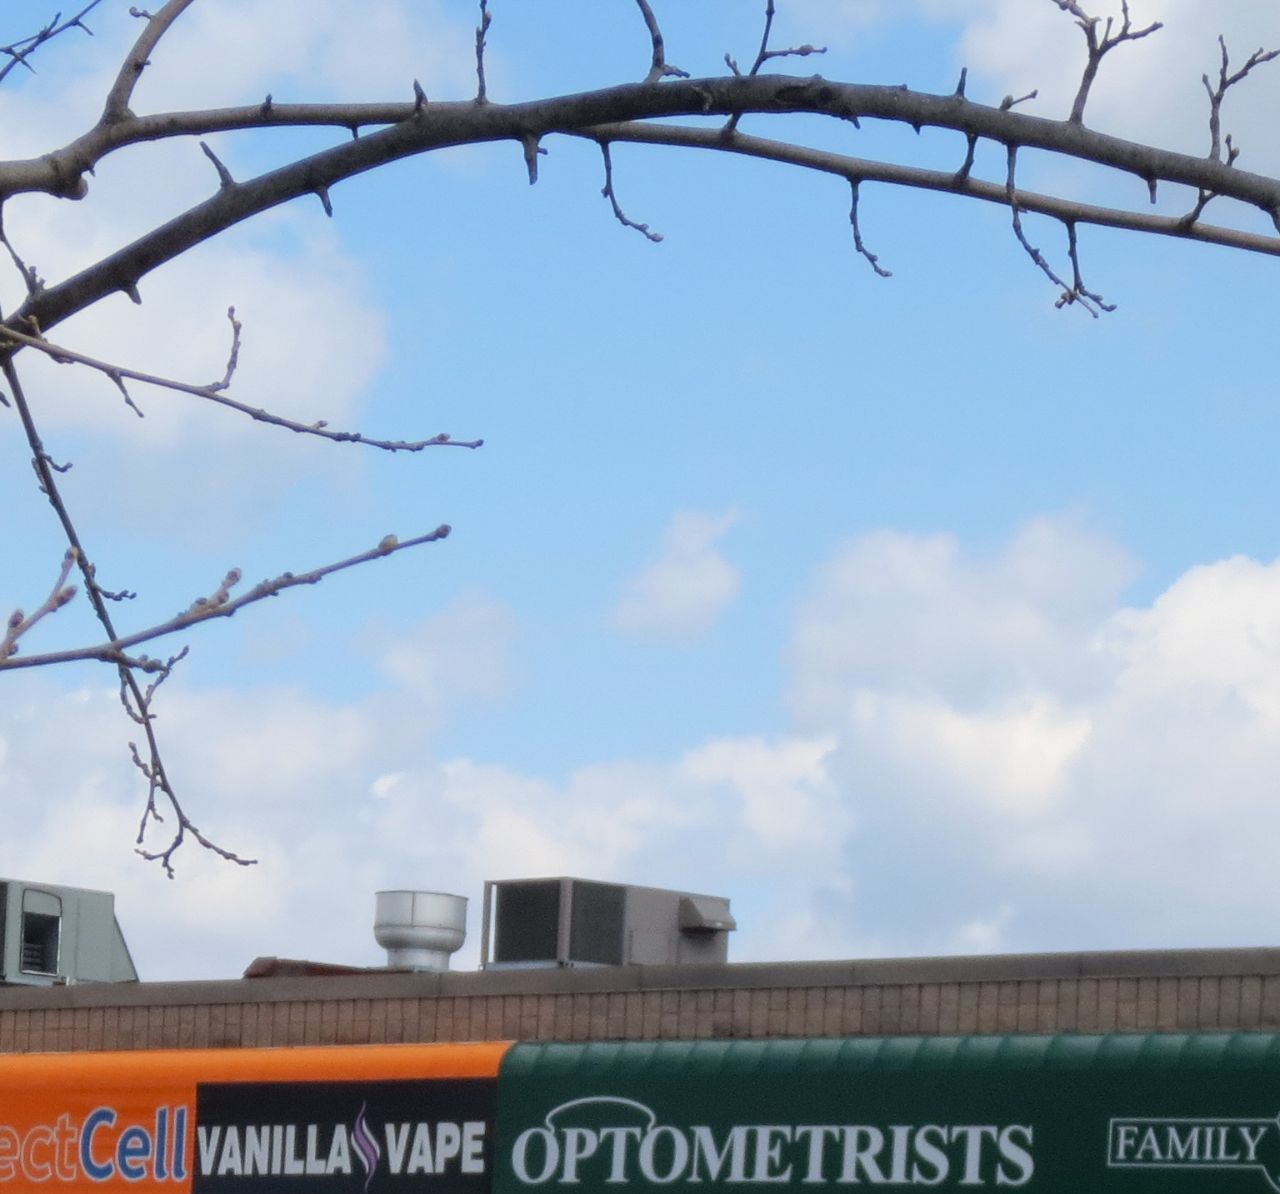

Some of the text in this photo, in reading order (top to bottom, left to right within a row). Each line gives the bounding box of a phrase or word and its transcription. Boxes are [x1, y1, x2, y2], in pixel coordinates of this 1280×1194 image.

[197, 1121, 486, 1176] VANILLA VAPE
[512, 1122, 1035, 1185] OPTOMETRISTS
[1116, 1126, 1267, 1162] FAMILY
